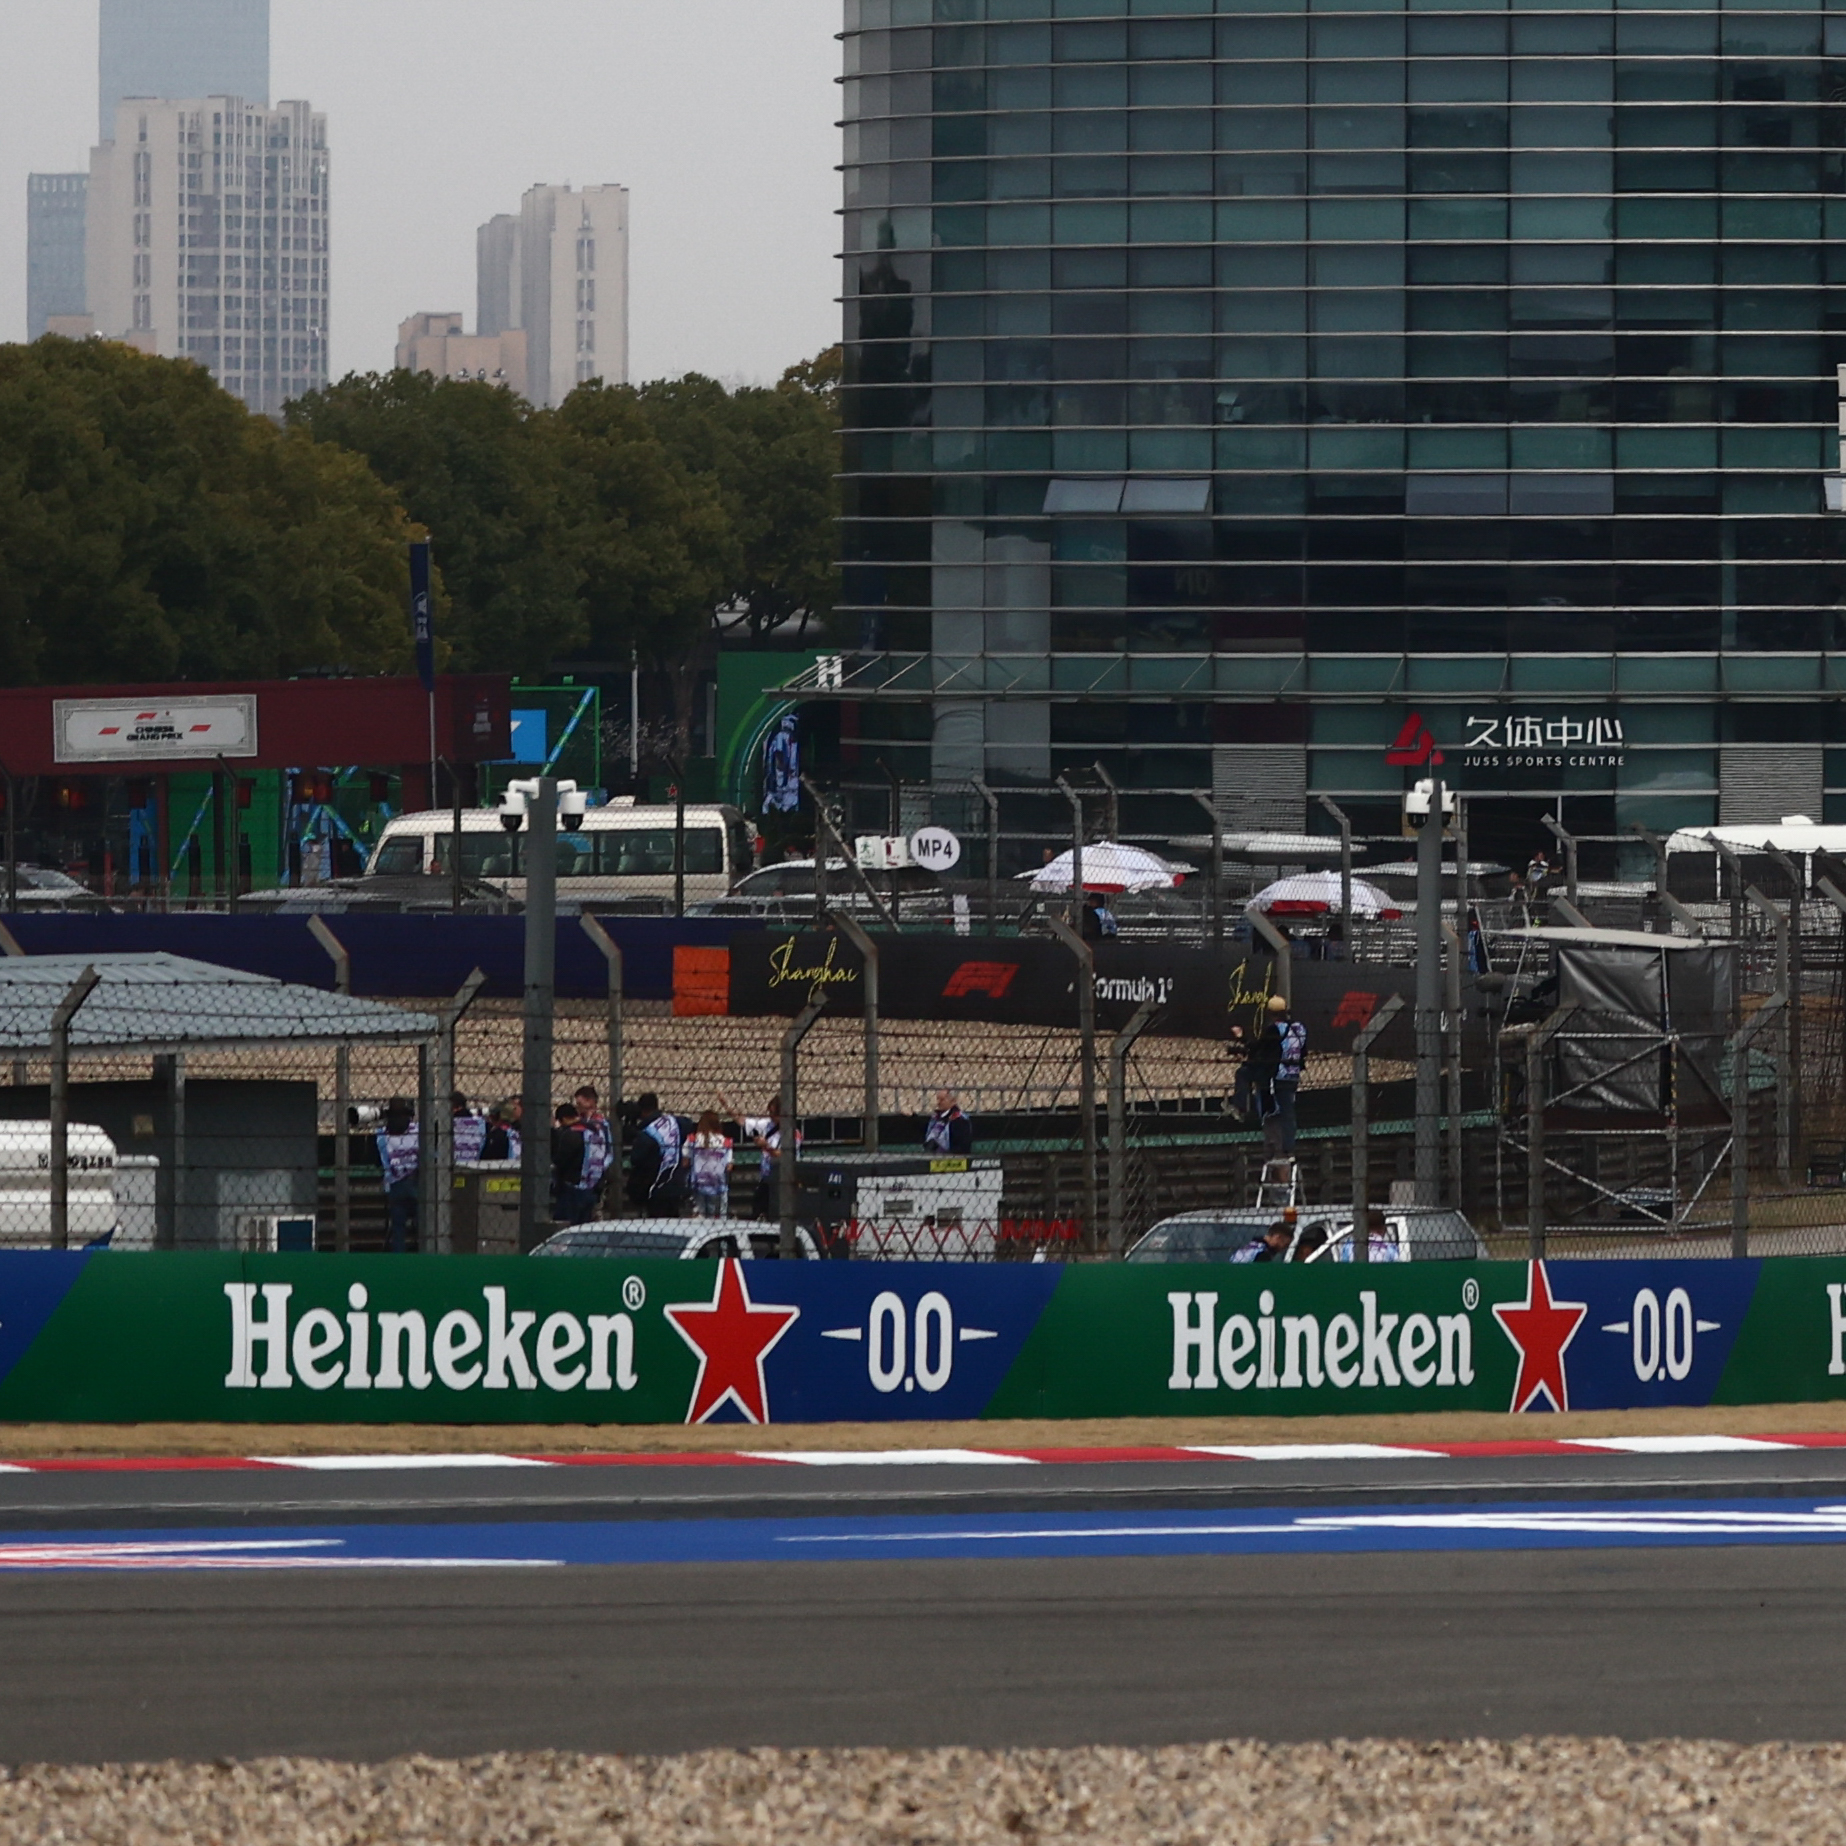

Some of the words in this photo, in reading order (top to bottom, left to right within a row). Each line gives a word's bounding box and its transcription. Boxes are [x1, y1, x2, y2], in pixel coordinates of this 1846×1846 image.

[1464, 716, 1624, 748] 久体中心
[1464, 756, 1500, 767] JUSS
[1507, 756, 1563, 767] SPORTS
[1570, 756, 1625, 766] CENTRE
[917, 838, 953, 860] MP4
[769, 935, 859, 1004] Shanghai
[869, 1292, 953, 1393] 0.0
[1634, 1288, 1693, 1382] 0.0
